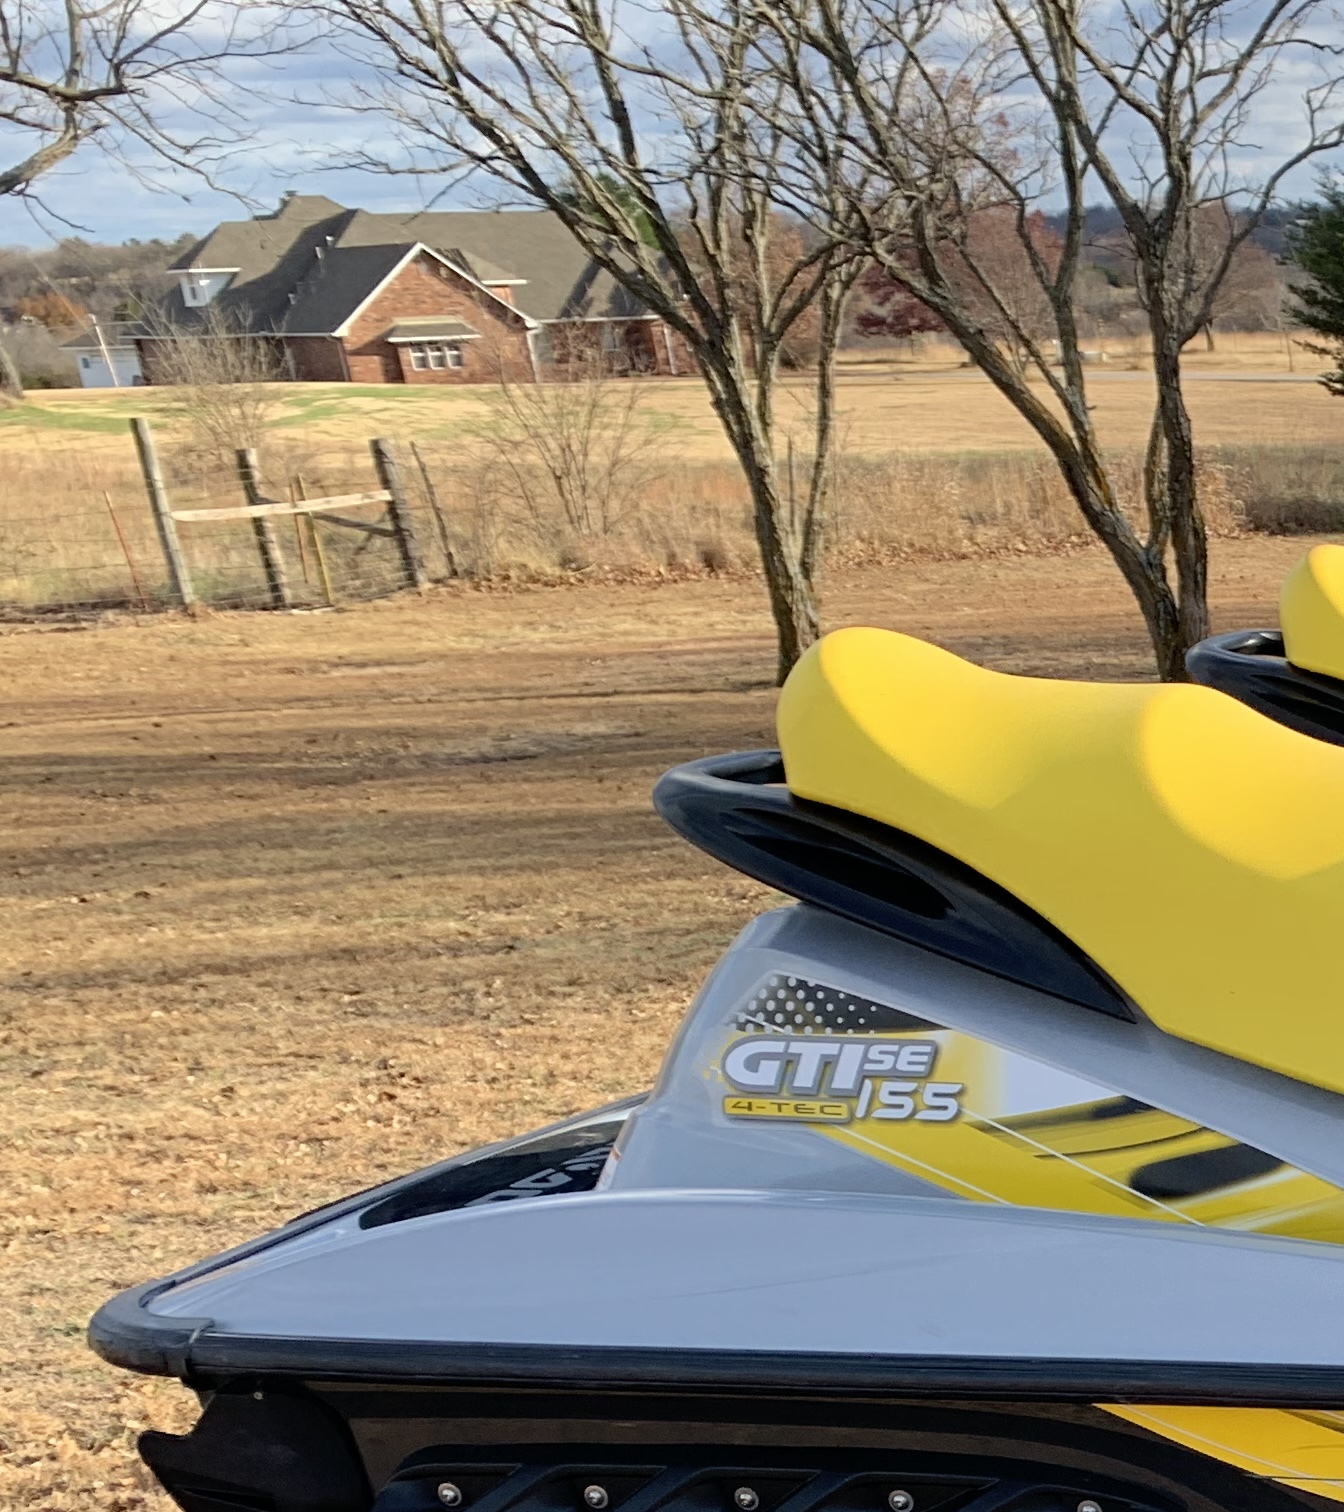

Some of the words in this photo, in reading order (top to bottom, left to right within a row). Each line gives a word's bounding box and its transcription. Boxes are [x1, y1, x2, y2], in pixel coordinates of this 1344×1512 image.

[863, 1044, 932, 1072] SE
[730, 1100, 844, 1117] 4-TEC
[855, 1079, 964, 1121] 155
